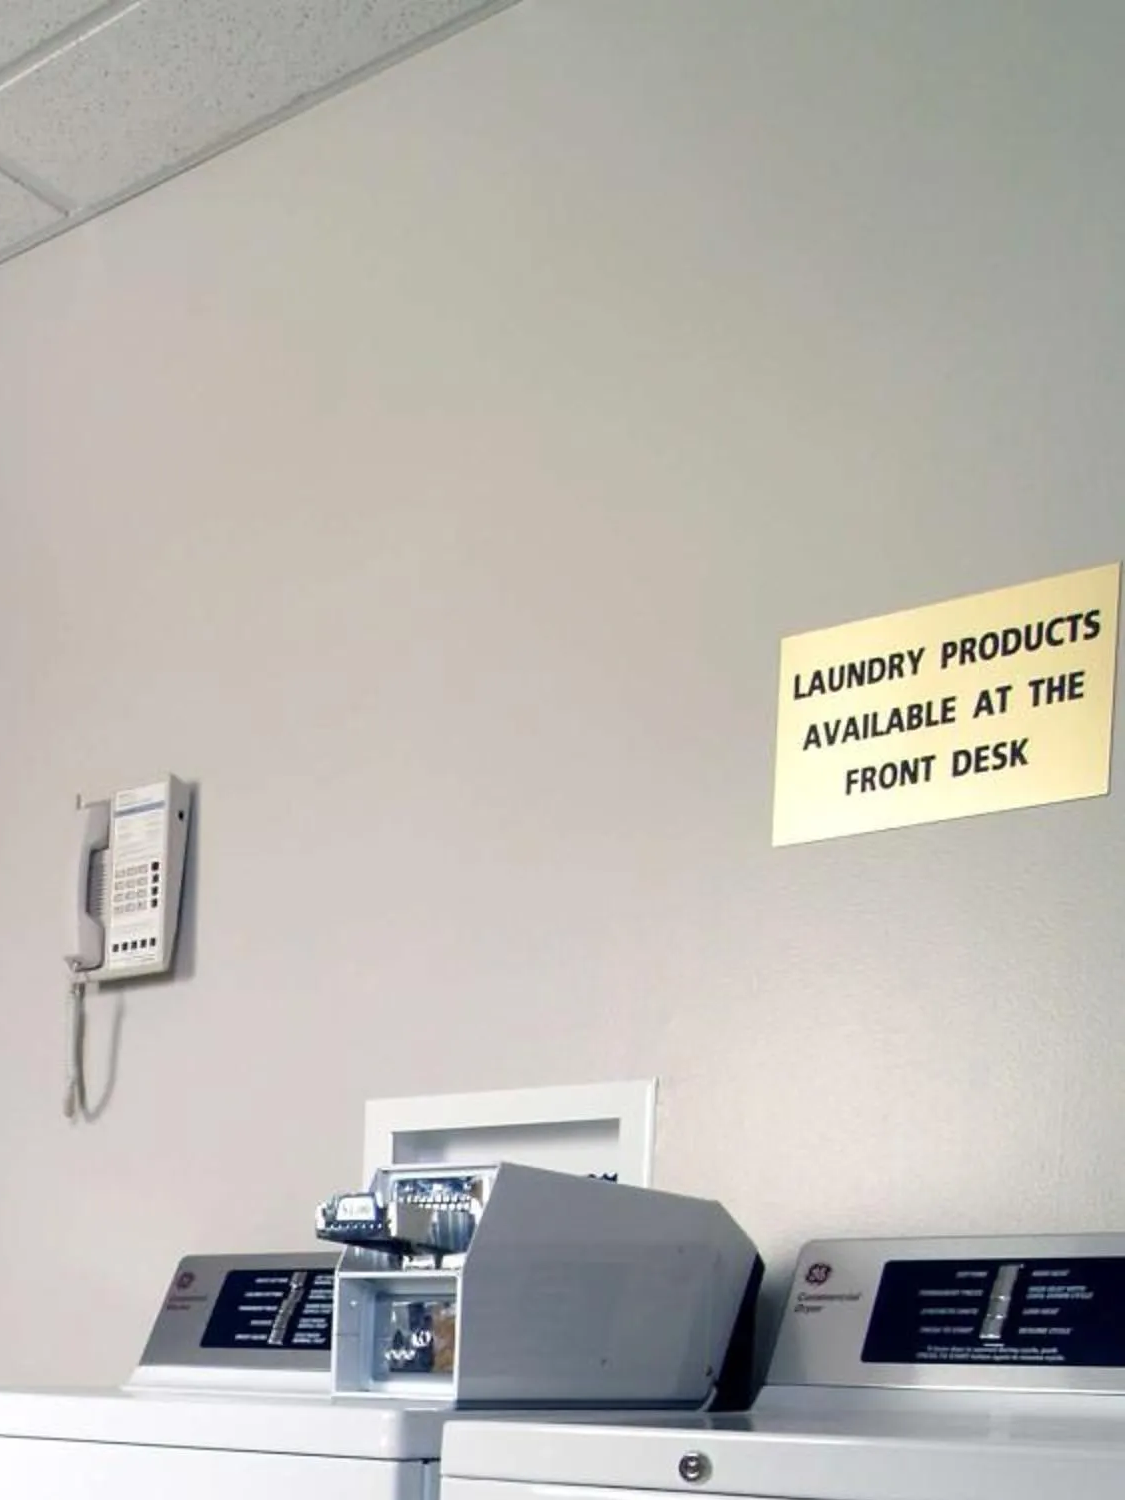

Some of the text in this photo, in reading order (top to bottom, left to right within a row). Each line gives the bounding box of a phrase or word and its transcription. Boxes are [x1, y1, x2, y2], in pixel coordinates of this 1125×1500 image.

[793, 610, 1100, 699] LAUNDRY PRODUCTS
[803, 671, 1085, 750] AVAILABLE AT THE
[846, 738, 1028, 794] FRONT DESK
